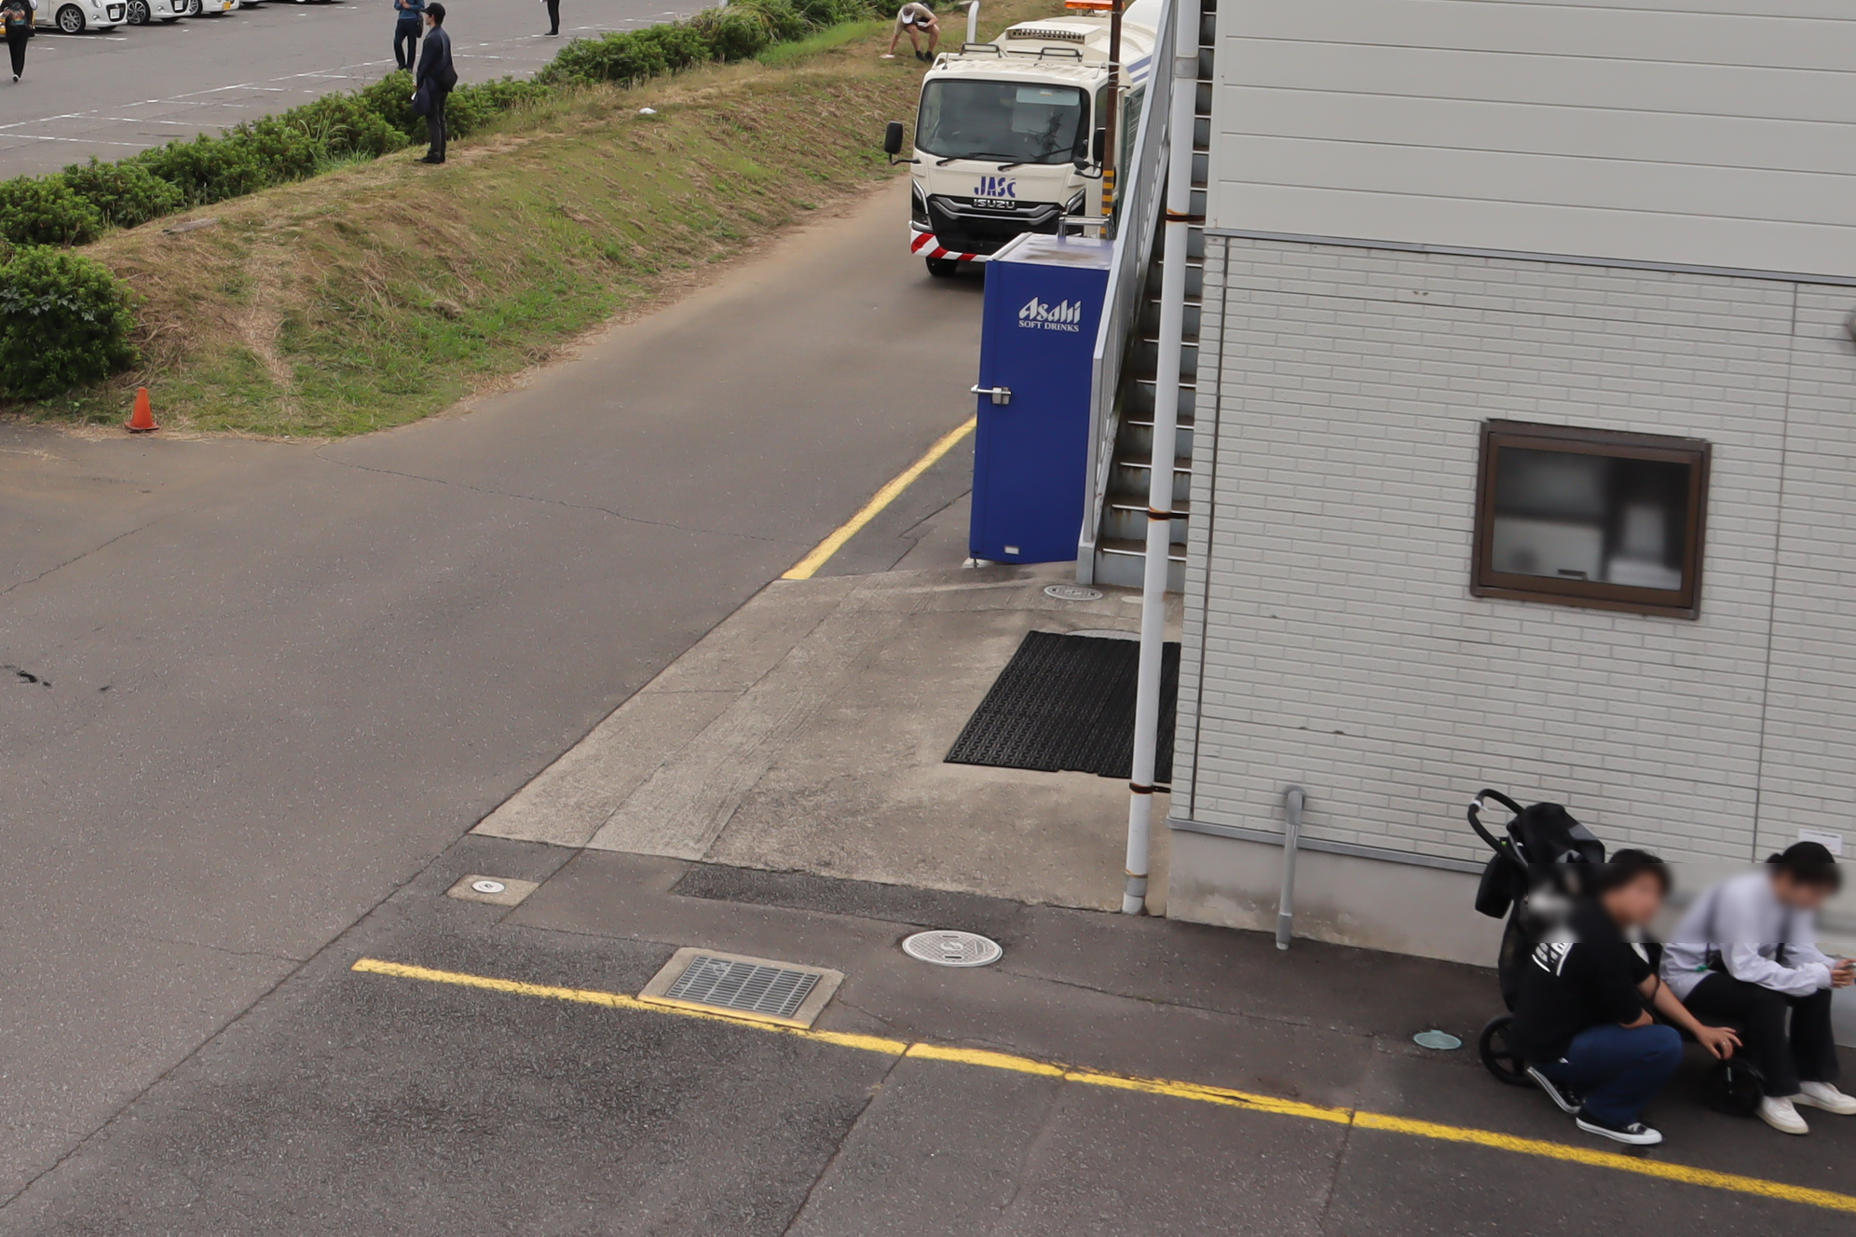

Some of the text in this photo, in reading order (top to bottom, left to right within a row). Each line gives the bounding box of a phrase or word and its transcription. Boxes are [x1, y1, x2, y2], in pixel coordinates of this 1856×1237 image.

[973, 175, 1017, 198] JASC
[973, 198, 1016, 209] ISUZU
[1018, 296, 1082, 324] Asahi
[1018, 319, 1080, 333] SOFT DRINKS
